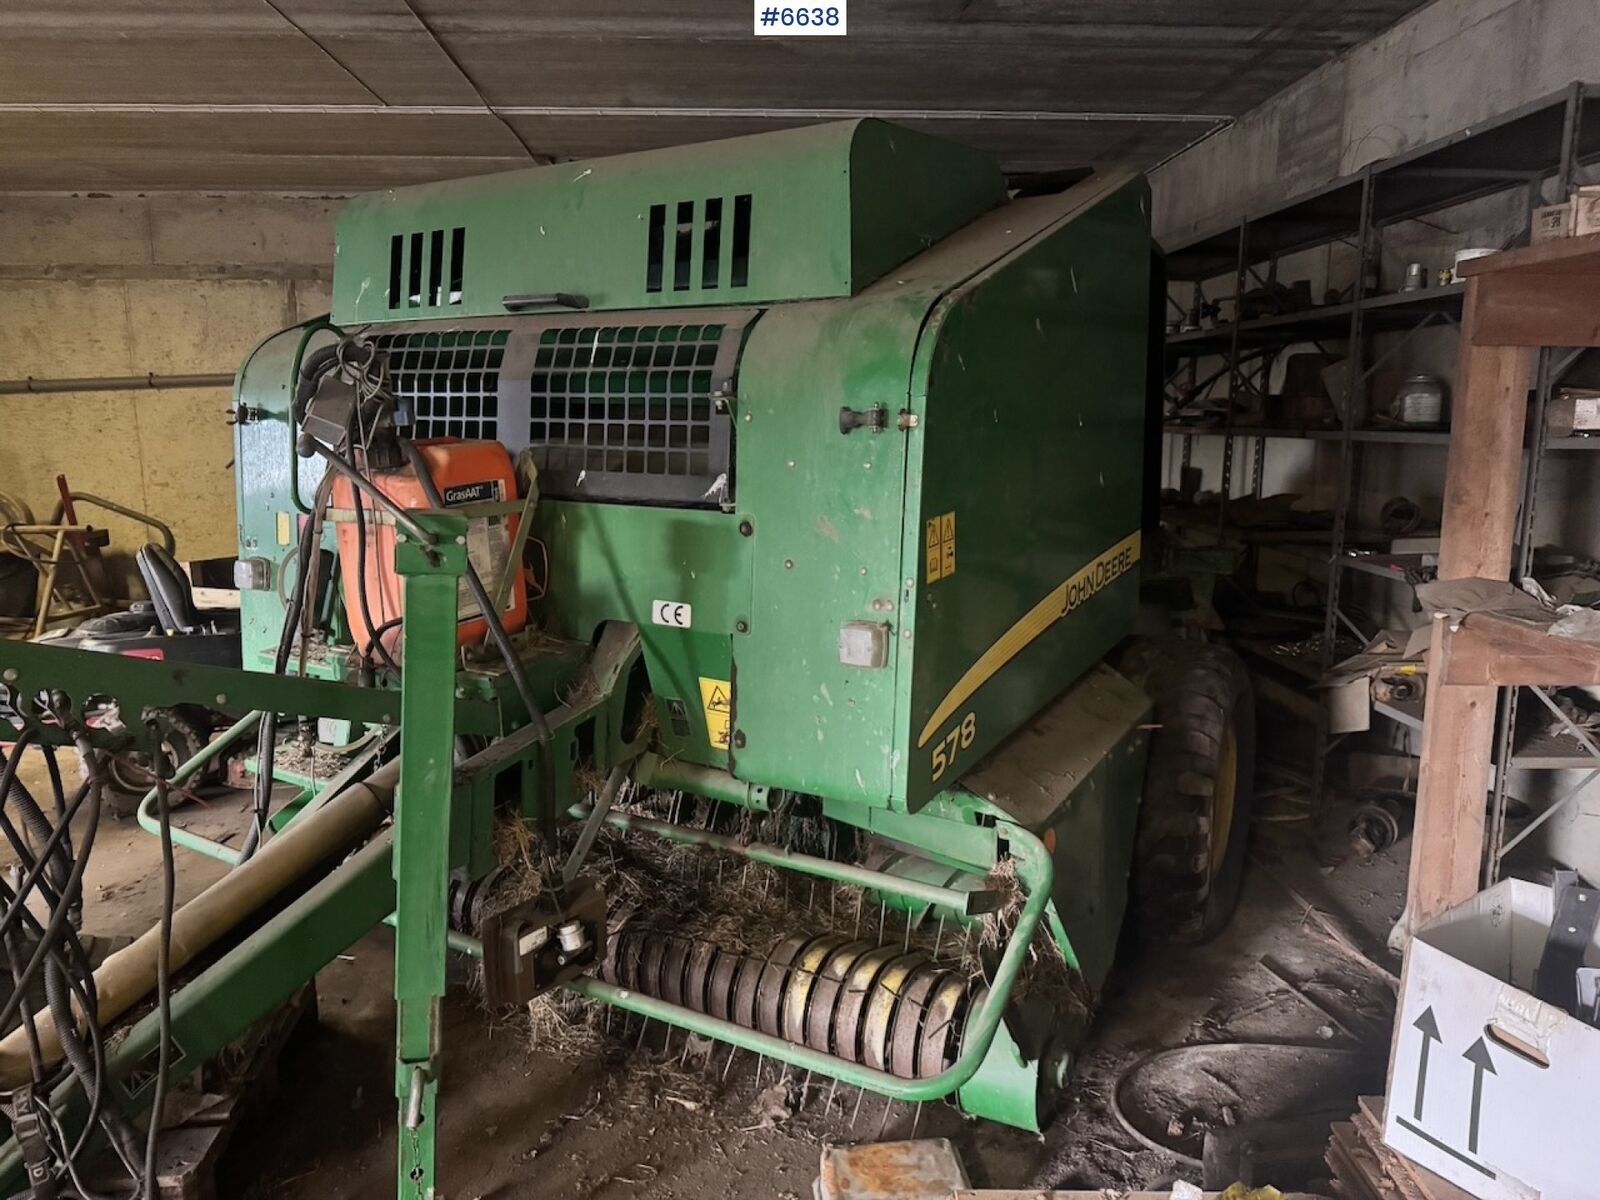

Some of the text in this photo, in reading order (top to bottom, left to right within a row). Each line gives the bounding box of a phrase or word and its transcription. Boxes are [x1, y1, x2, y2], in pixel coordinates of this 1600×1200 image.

[660, 603, 683, 625] CE
[1061, 546, 1132, 615] JOHN DEERE
[931, 711, 976, 782] 578
